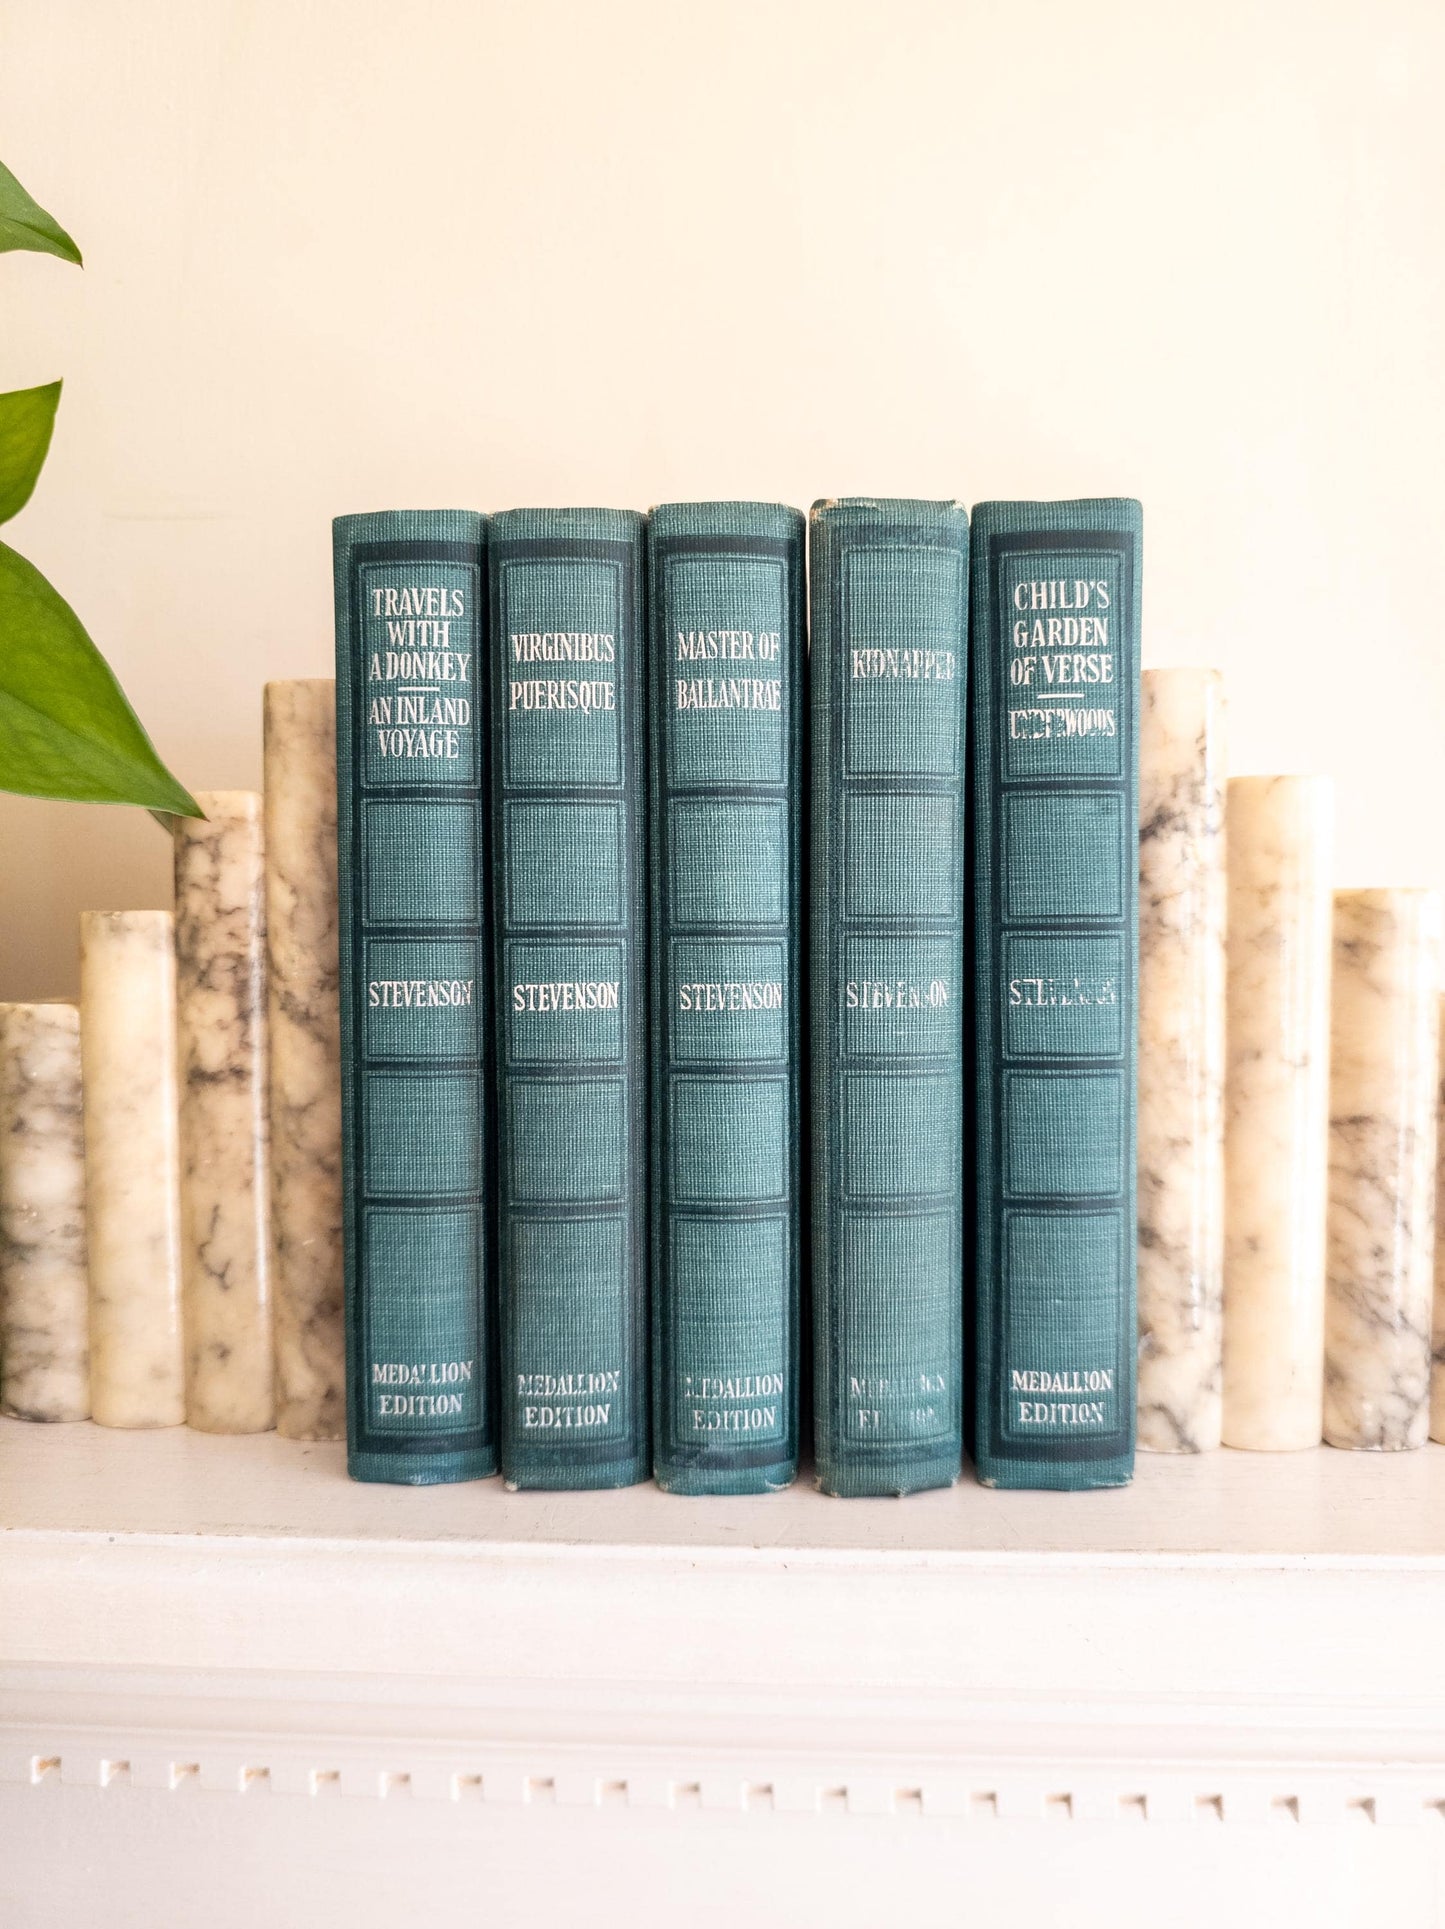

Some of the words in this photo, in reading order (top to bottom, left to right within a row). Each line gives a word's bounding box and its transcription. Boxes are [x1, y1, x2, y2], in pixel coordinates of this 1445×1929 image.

[373, 588, 464, 617] TRAVELS
[1014, 581, 1110, 610] CHILD'S
[388, 620, 450, 648] WITH
[677, 630, 755, 661] MASTER
[758, 631, 780, 662] OF
[1013, 617, 1108, 648] GARDEN
[511, 633, 614, 662] VIRGINIBUS
[369, 654, 382, 681] A
[386, 651, 471, 682] DONKEY
[1010, 656, 1037, 686] OF
[1042, 654, 1114, 684] VERSE
[509, 680, 615, 714] PUERISQUE
[676, 678, 781, 710] BALLANTRAE
[369, 697, 393, 724] AN
[397, 697, 470, 725] INLAND
[378, 729, 459, 758] VOYAGE
[369, 980, 473, 1008] STEVENSON
[514, 982, 619, 1011] STEVENSON
[679, 982, 782, 1011] STEVENSON
[1011, 1369, 1113, 1393] MEDALLION
[380, 1394, 464, 1416] EDITION
[525, 1404, 610, 1429] EDITION
[693, 1407, 776, 1430] EDITION
[1019, 1402, 1105, 1424] EDITION
